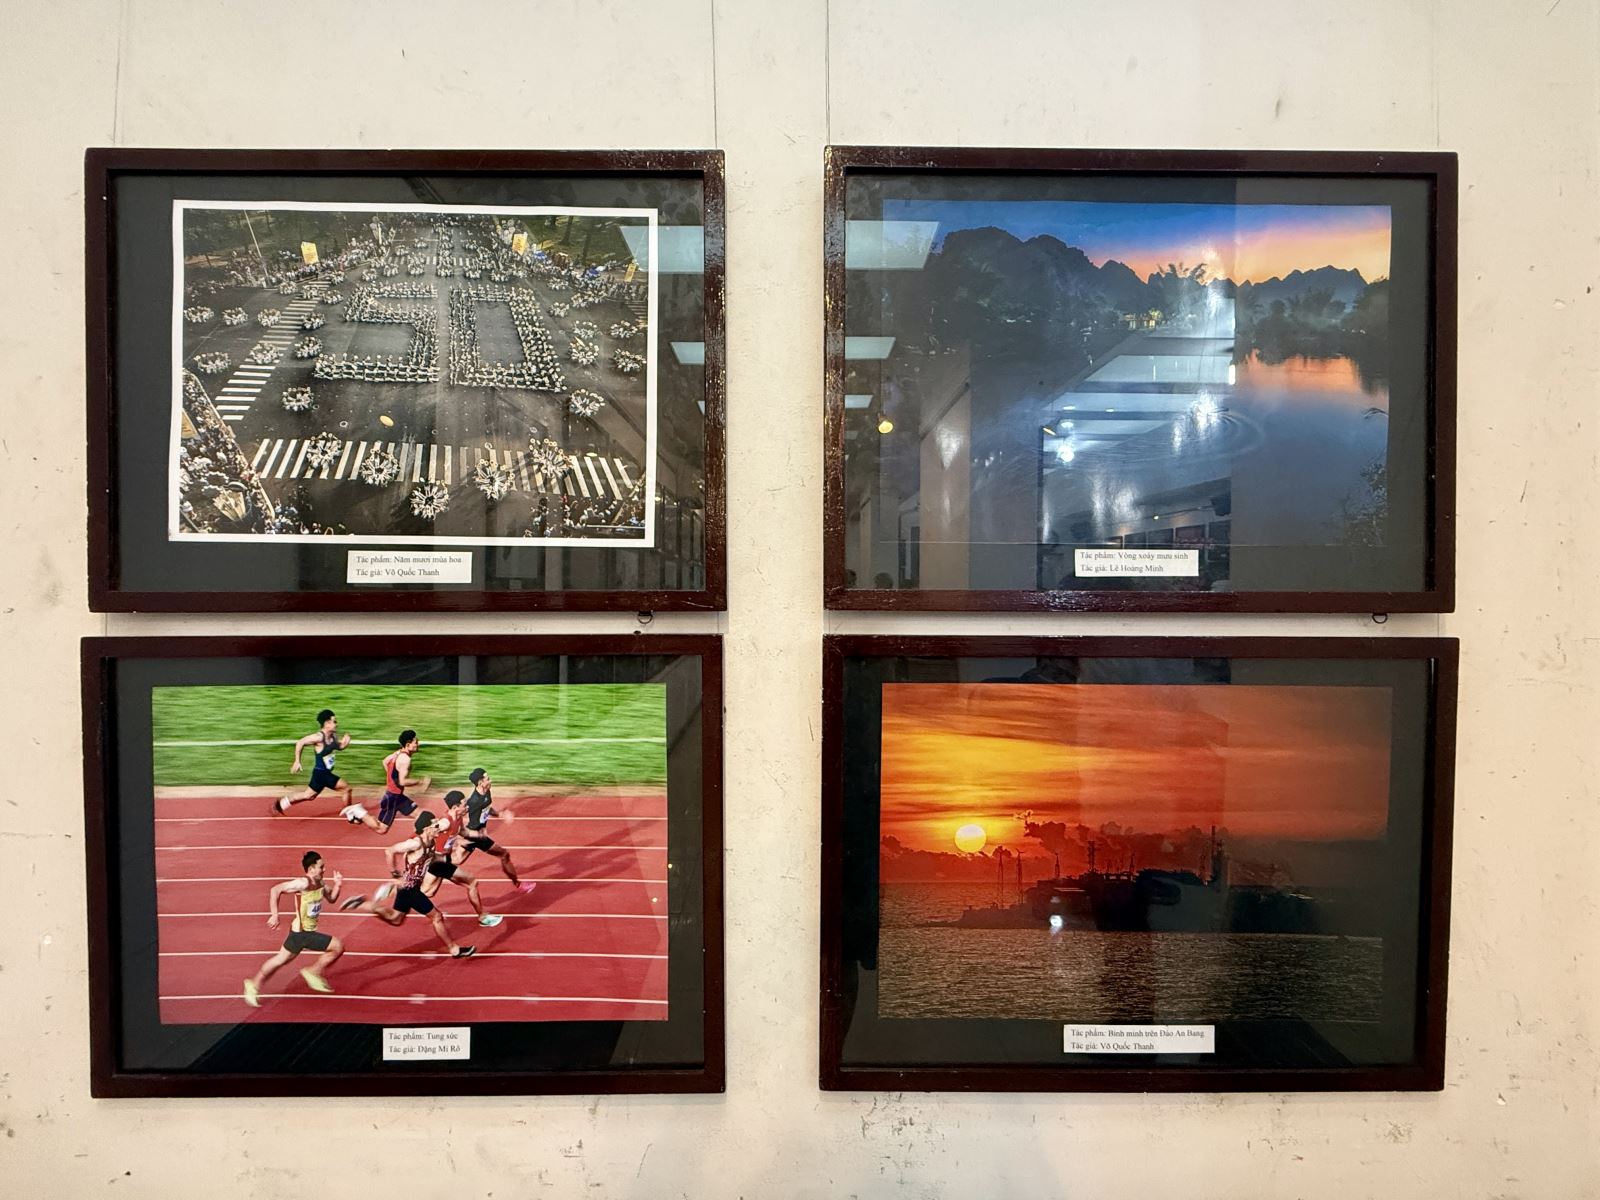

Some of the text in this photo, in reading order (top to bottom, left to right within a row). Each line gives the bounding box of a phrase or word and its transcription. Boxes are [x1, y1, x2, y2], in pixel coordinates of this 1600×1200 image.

[356, 555, 369, 564] Tác
[370, 555, 391, 566] phẩm:
[394, 555, 411, 564] Năm
[432, 556, 447, 564] mùa
[449, 555, 462, 564] hoa
[1080, 551, 1093, 560] Tác
[1094, 550, 1115, 561] phẩm:
[1118, 551, 1137, 561] Vòng
[1138, 552, 1155, 561] xoáy
[1174, 551, 1189, 560] sinh
[356, 567, 440, 578] Tác giả: Võ Quốc Thanh
[1081, 564, 1093, 572] Tác
[1109, 564, 1119, 572] Lê
[1120, 564, 1143, 573] Hoàng
[1145, 564, 1164, 572] Minh
[388, 1032, 458, 1041] Tác phẩm: Tung sức
[1071, 1028, 1205, 1039] Tác phẩm: Bình minh trên Đảo An Bang
[388, 1045, 401, 1053] Tác
[402, 1045, 416, 1054] giả:
[417, 1045, 437, 1054] Đặng
[438, 1045, 449, 1053] Mi
[1071, 1040, 1155, 1052] Tác giả: Võ Quốc Thanh
